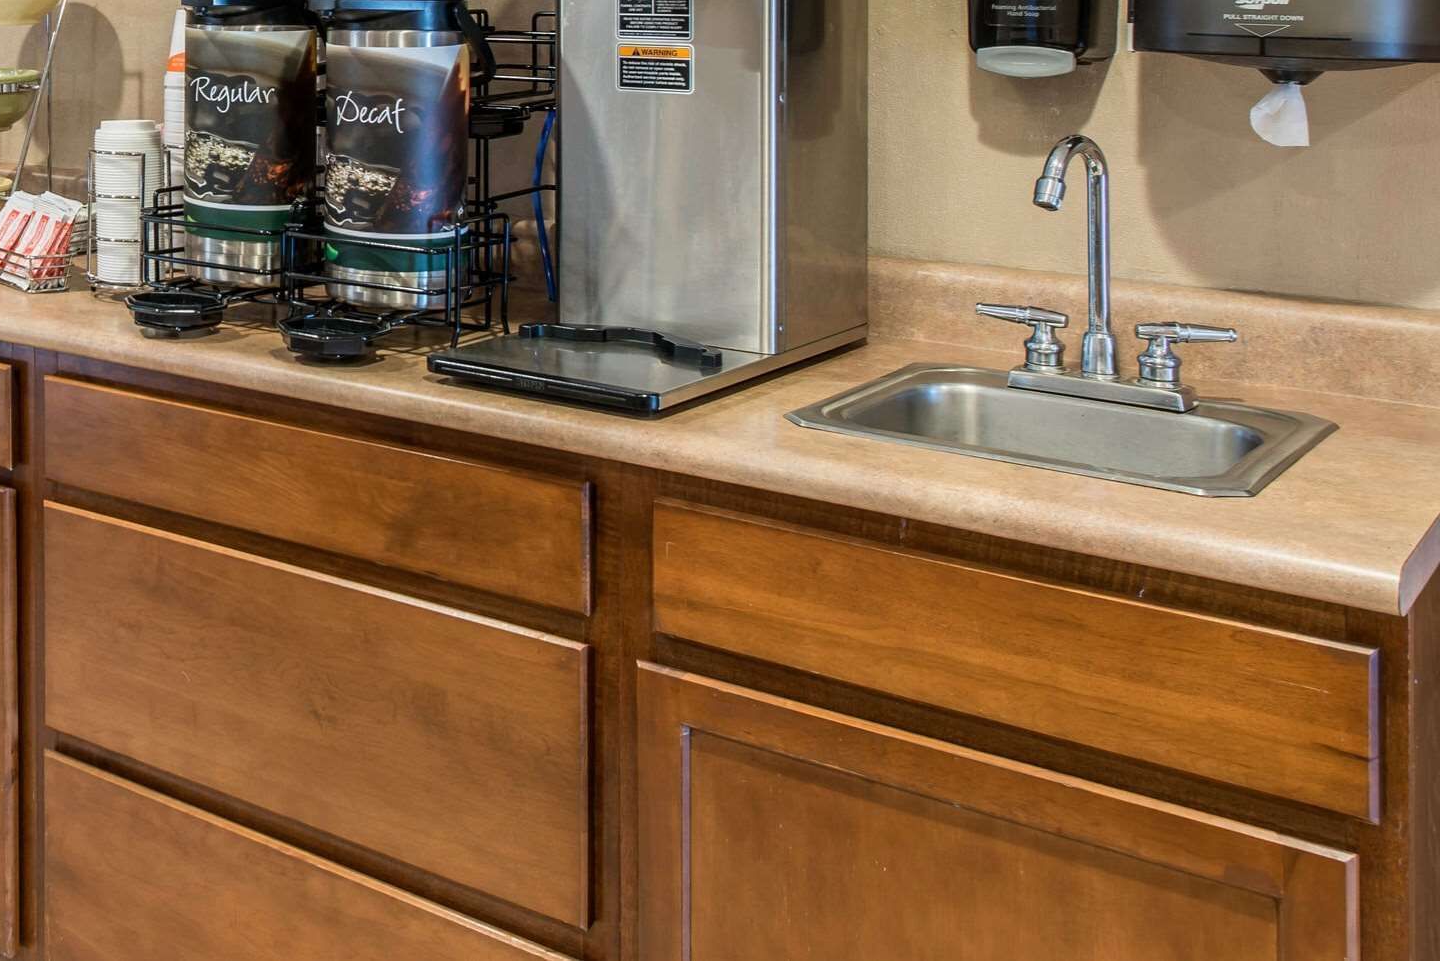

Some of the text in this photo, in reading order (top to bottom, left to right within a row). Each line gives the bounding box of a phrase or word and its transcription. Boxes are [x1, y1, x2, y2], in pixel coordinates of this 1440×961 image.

[641, 48, 678, 57] WARNING
[189, 76, 276, 114] Regular
[335, 90, 407, 134] Decaf
